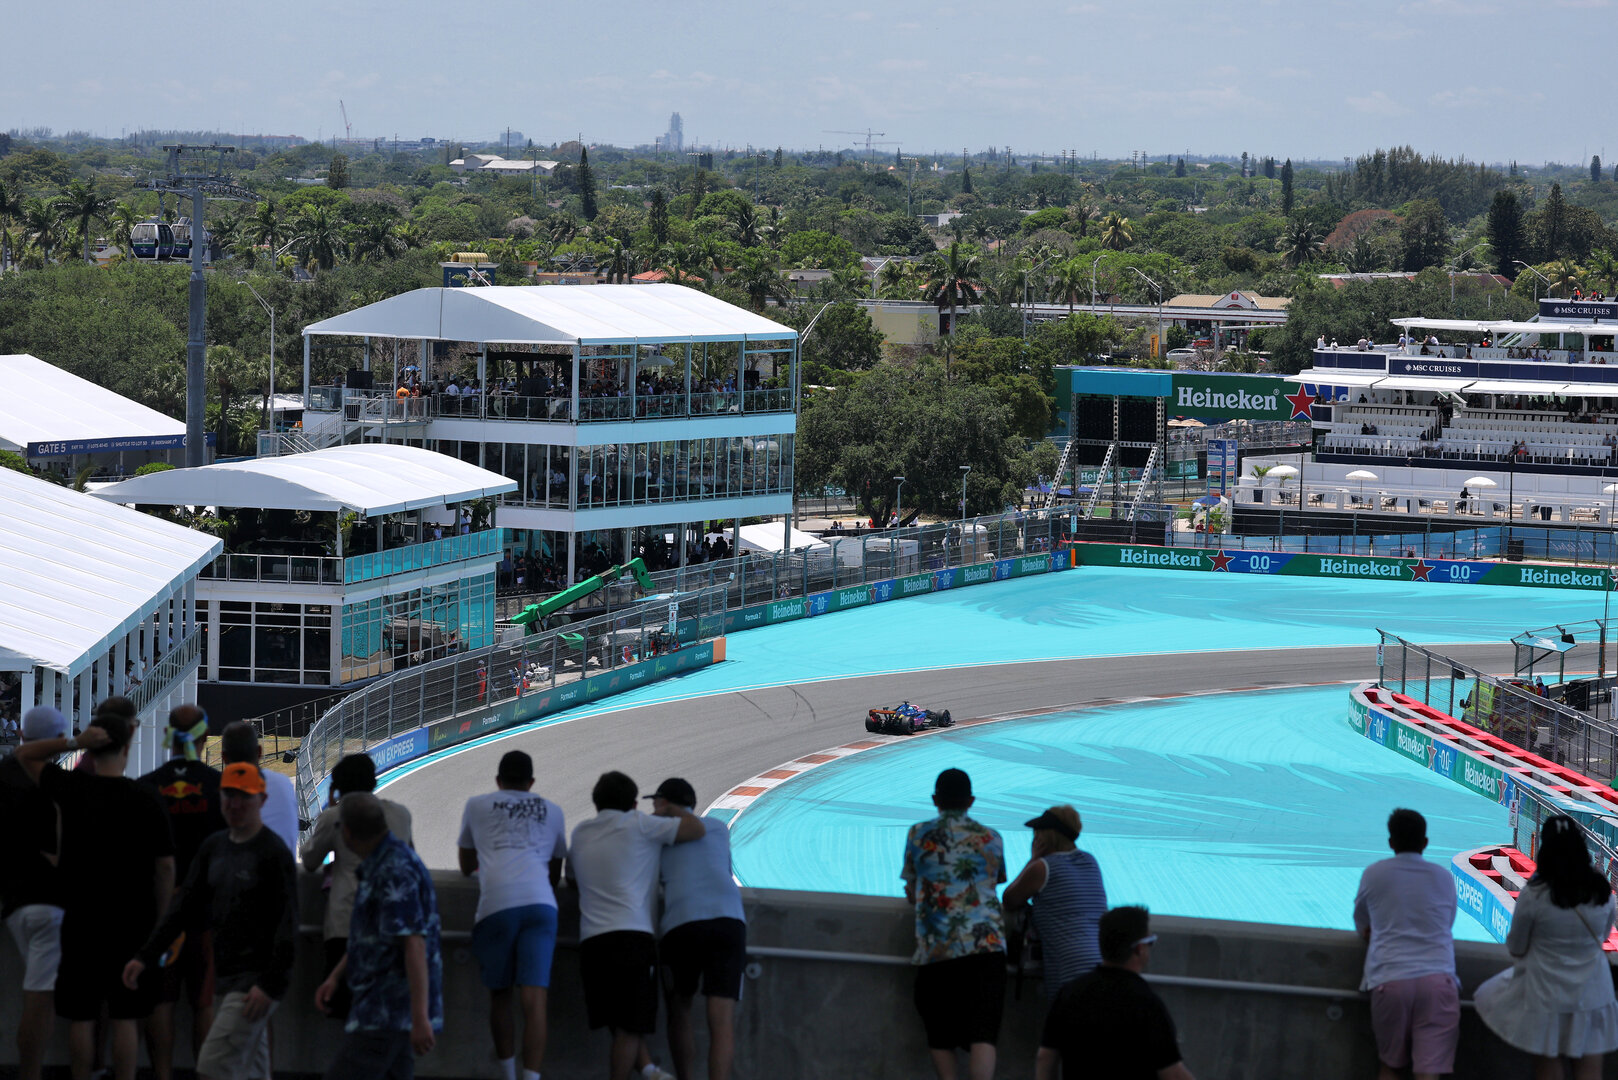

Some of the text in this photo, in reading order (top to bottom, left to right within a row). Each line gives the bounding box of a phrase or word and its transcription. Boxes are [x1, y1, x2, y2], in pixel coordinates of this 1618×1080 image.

[1577, 307, 1611, 315] CRUISES
[1412, 364, 1462, 373] MSC CRUISES
[1177, 386, 1278, 411] Heineken
[38, 443, 66, 454] GATE 5
[1022, 558, 1045, 572] Heineken
[1120, 548, 1201, 568] Heineken
[1250, 555, 1270, 570] 0.0
[964, 566, 989, 582] Heineken
[1319, 558, 1401, 577] Heineken
[1450, 564, 1471, 580] 0.0
[904, 577, 930, 593] Heineken
[1520, 568, 1603, 587] Heineken
[840, 588, 868, 606] Heineken
[773, 601, 802, 620] Heineken
[482, 715, 497, 726] Formula
[386, 736, 414, 762] EXPRESS
[1398, 728, 1425, 760] Heineken
[1465, 760, 1496, 795] Heineken
[493, 800, 547, 816] NORTH
